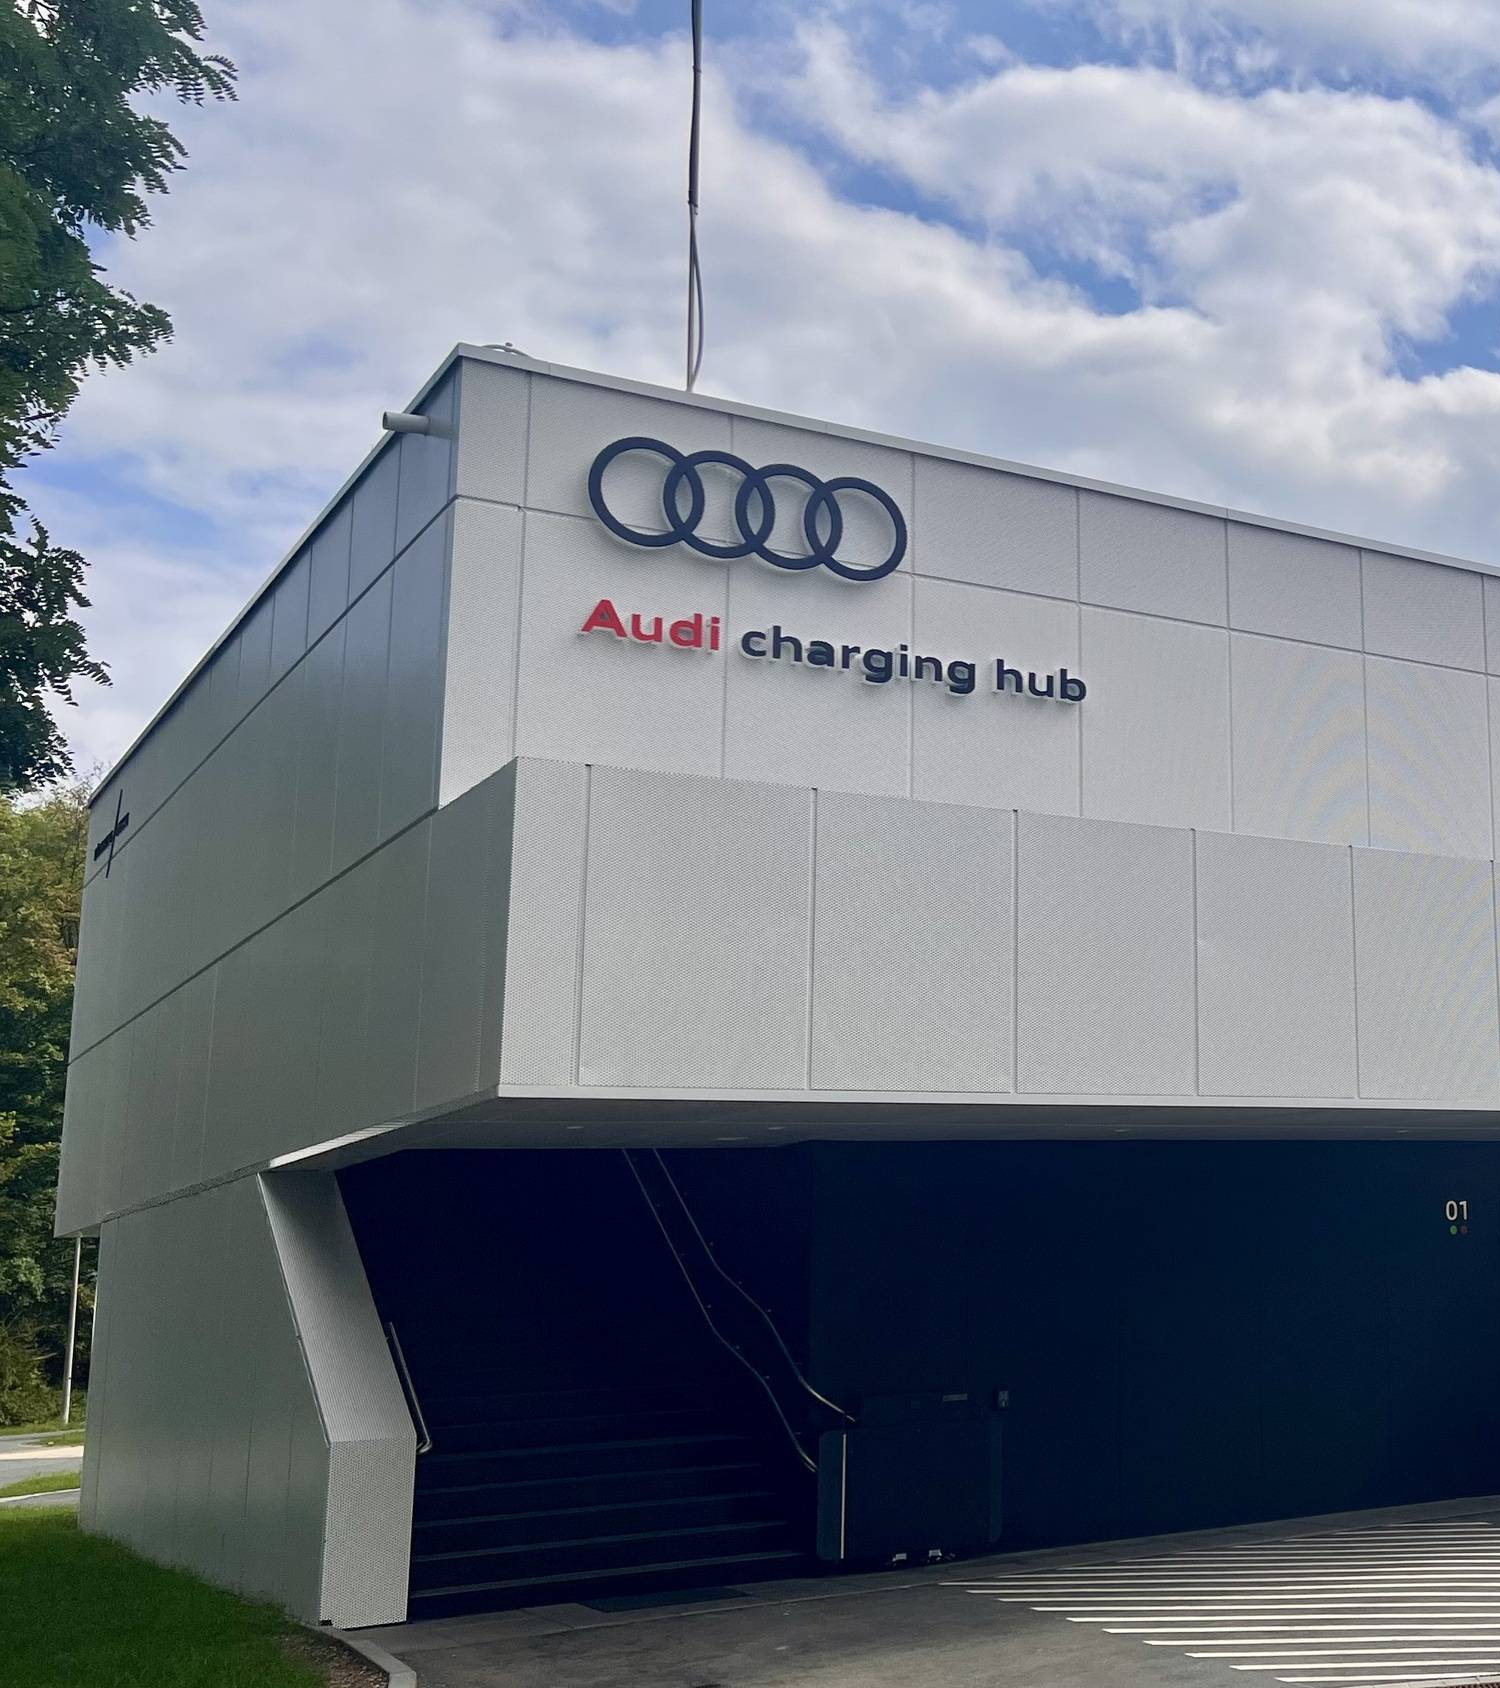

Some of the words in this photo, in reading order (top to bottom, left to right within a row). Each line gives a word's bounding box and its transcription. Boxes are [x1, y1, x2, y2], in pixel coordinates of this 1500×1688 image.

[581, 599, 720, 651] Audi
[740, 625, 976, 696] charging
[996, 658, 1087, 703] hub
[1445, 1200, 1468, 1221] 01
